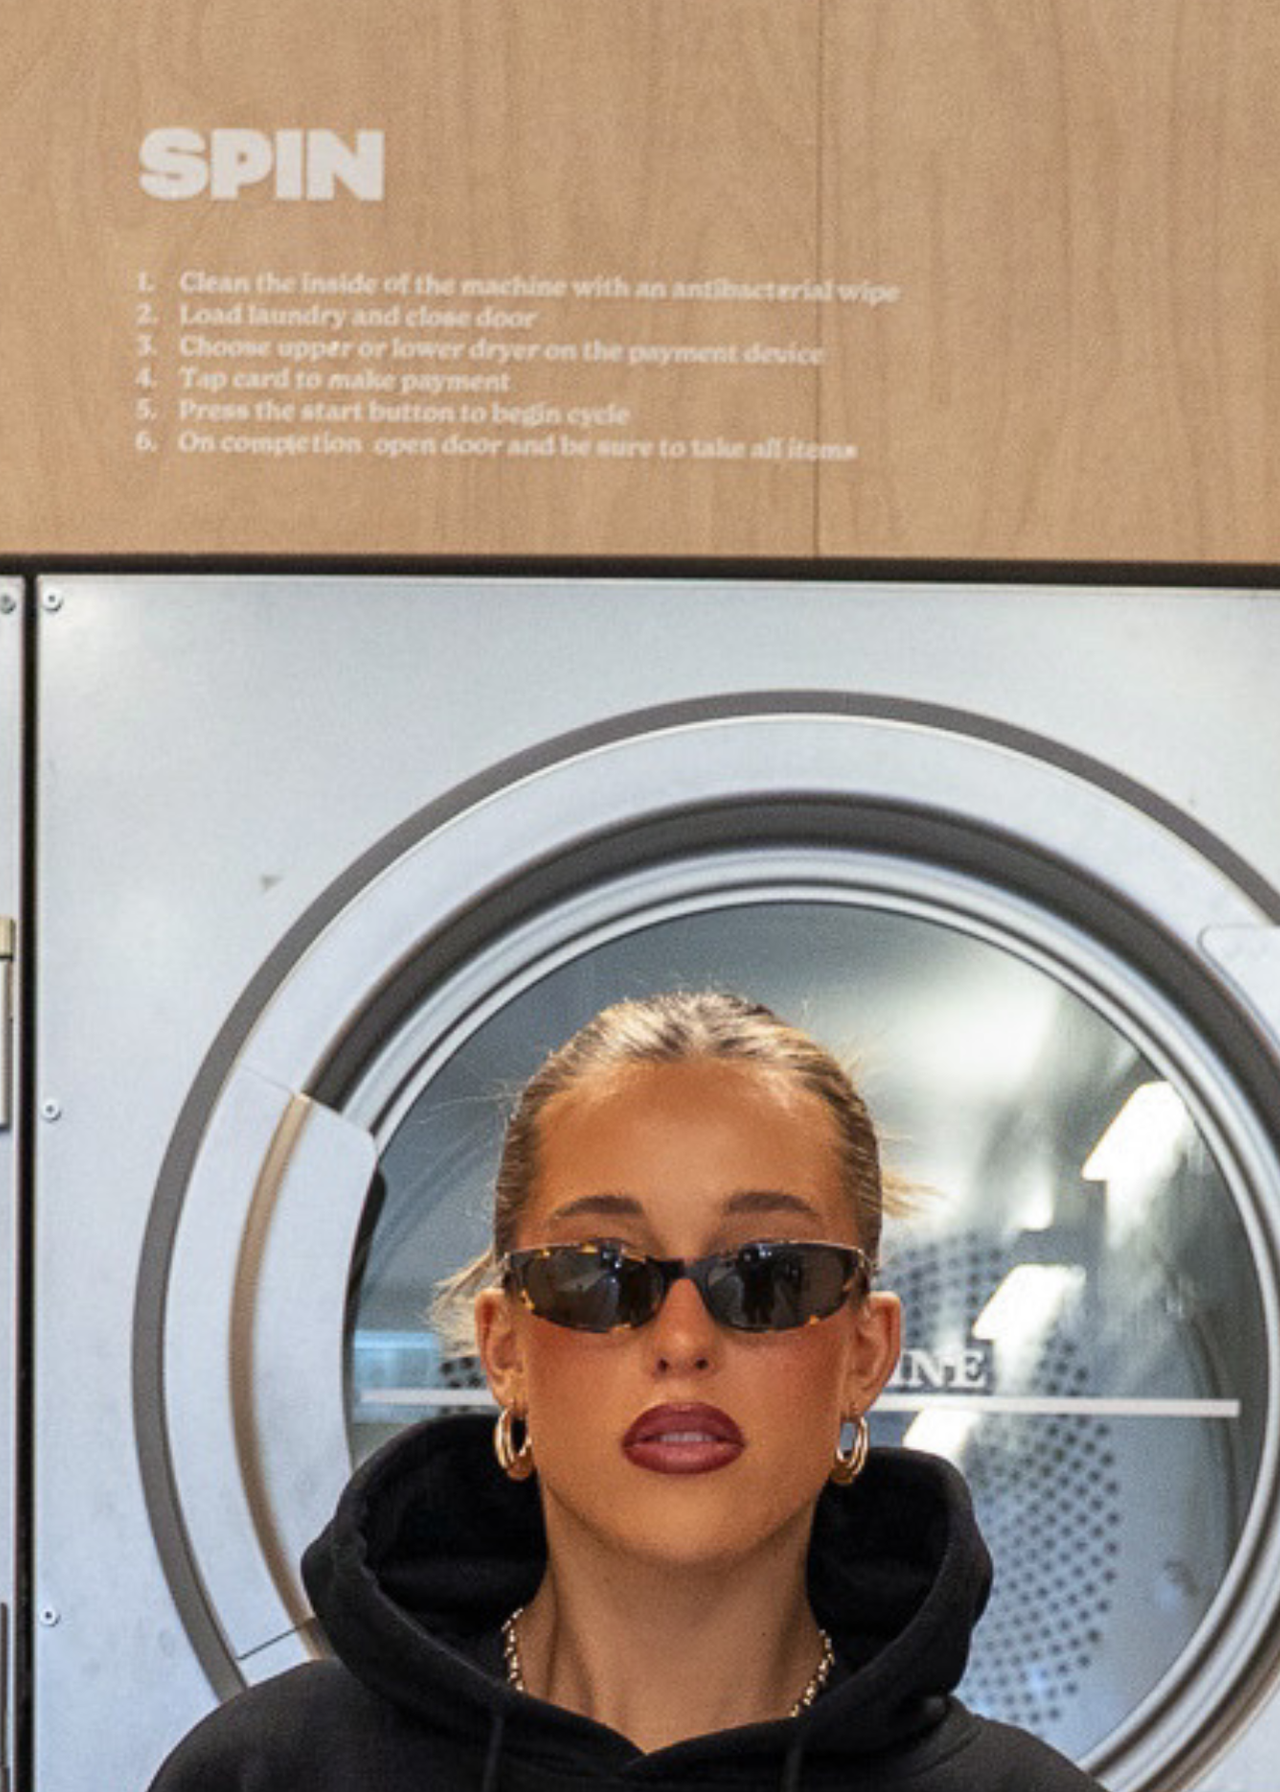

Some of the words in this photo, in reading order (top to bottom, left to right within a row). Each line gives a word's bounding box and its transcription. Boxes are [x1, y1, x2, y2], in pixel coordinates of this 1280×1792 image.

[139, 127, 384, 200] SPIN
[179, 271, 249, 293] Clean
[255, 272, 297, 294] the
[302, 273, 377, 295] inside
[383, 273, 412, 295] of
[415, 274, 454, 295] the
[461, 275, 567, 297] machine
[571, 276, 629, 298] with
[635, 283, 667, 298] an
[672, 278, 833, 300] antibacterial
[837, 280, 900, 305] wipe
[180, 304, 242, 325] Load
[249, 304, 344, 329] laundry
[352, 305, 400, 327] and
[406, 305, 471, 327] close
[477, 306, 538, 328] door
[180, 335, 269, 357] Choose
[277, 342, 350, 362] upper
[358, 342, 387, 358] or
[392, 336, 466, 359] lower
[470, 337, 541, 363] dryer
[545, 344, 577, 360] on
[583, 339, 623, 361] the
[628, 344, 736, 366] payment
[743, 342, 824, 364] device
[180, 366, 227, 391] Tap
[233, 367, 290, 389] card
[296, 371, 322, 390] to
[328, 369, 396, 391] make
[402, 372, 511, 395] payment
[180, 399, 249, 421] Press
[255, 399, 295, 422] the
[301, 403, 363, 422] start
[370, 399, 458, 423] button
[461, 404, 487, 423] to
[492, 401, 562, 428] begin
[568, 403, 631, 426] cycle
[887, 1349, 986, 1388] INE
